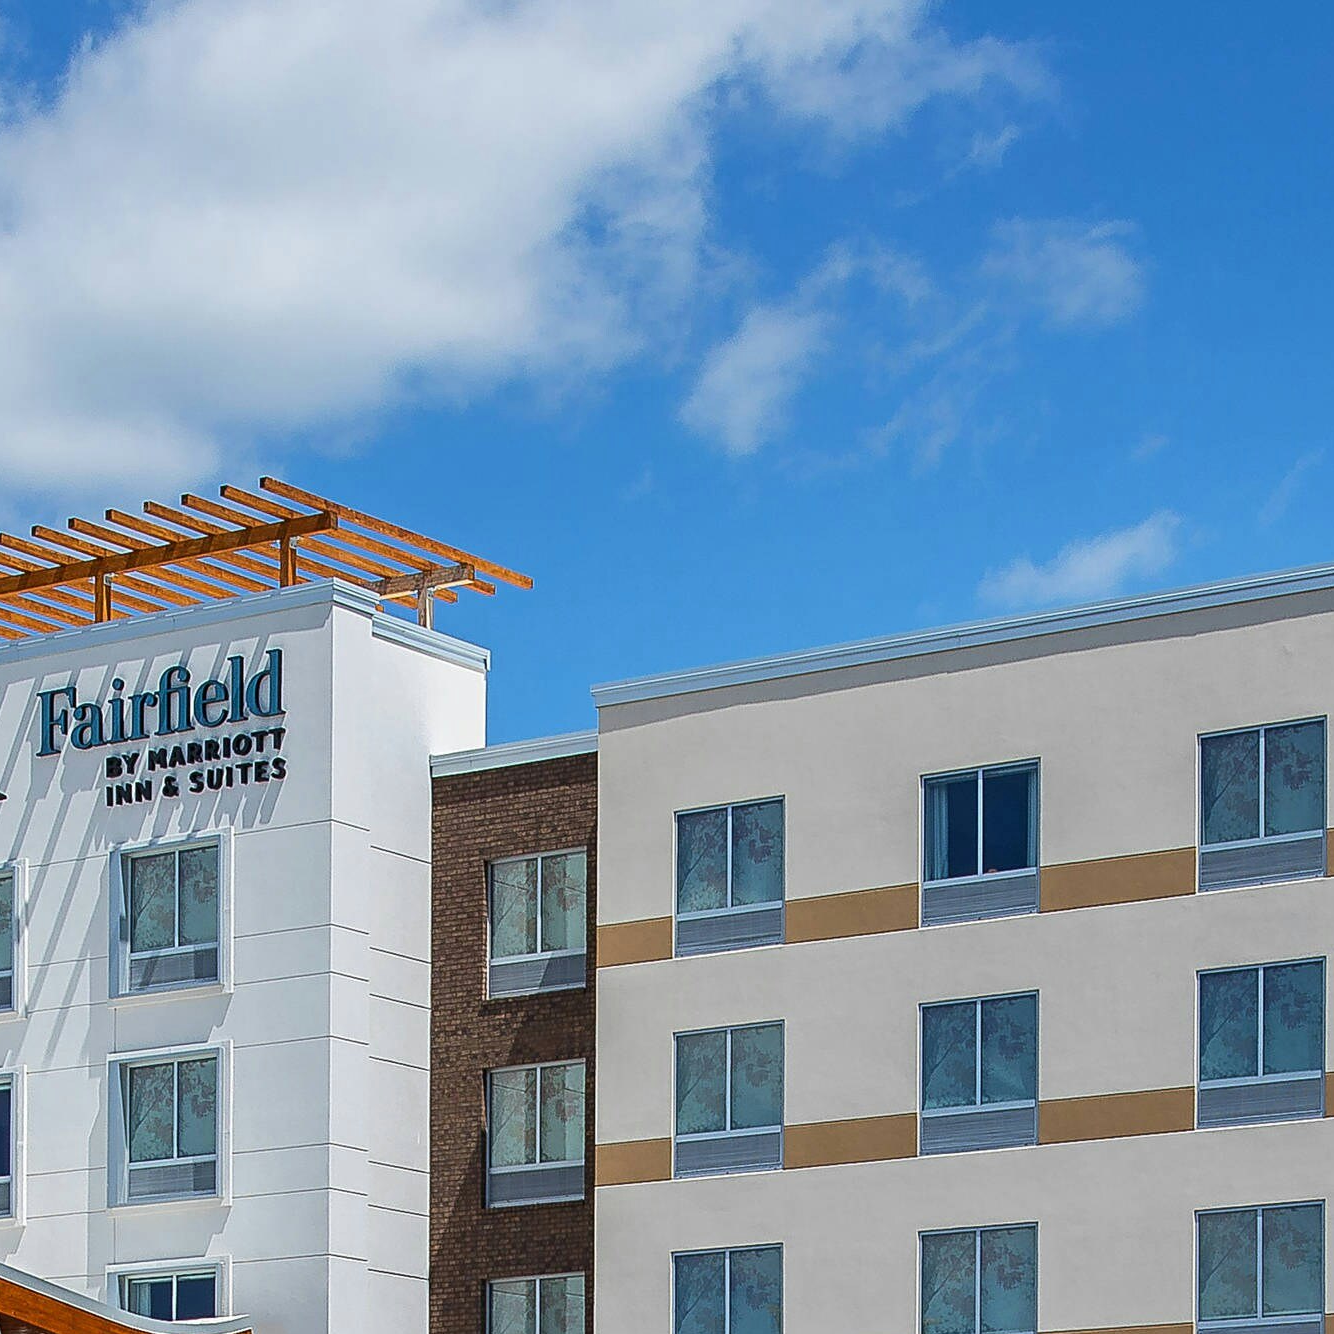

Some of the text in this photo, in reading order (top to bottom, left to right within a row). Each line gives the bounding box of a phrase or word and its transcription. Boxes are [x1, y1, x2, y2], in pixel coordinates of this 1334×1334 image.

[35, 648, 286, 757] Fairfield
[105, 727, 286, 778] BY MARRIOTT
[106, 757, 286, 807] INN & SUITES
